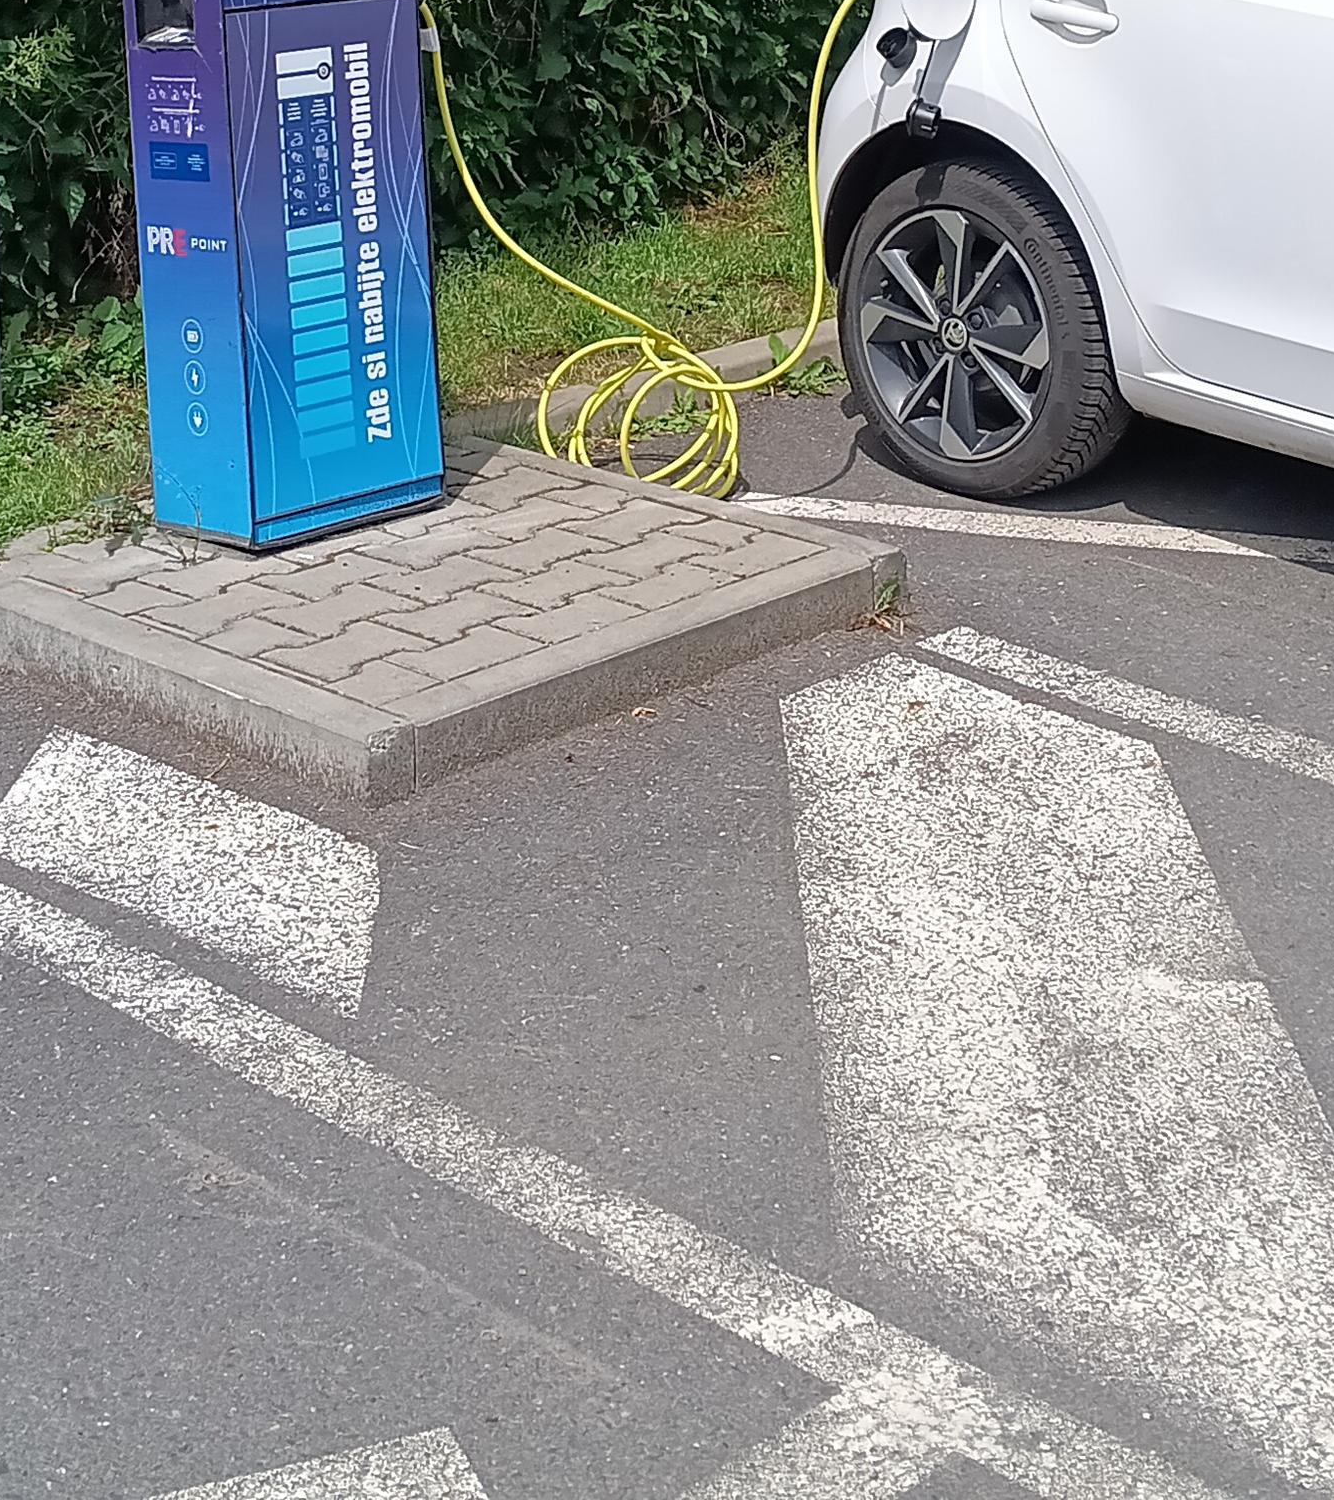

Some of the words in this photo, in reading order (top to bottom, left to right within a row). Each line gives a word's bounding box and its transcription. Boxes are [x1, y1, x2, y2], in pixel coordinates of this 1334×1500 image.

[343, 42, 379, 232] elektromobil
[147, 225, 188, 257] PRE
[190, 237, 227, 252] POINT
[357, 242, 387, 344] nabijte
[1024, 238, 1069, 325] Continental
[362, 351, 387, 380] si
[366, 387, 393, 443] Zde
